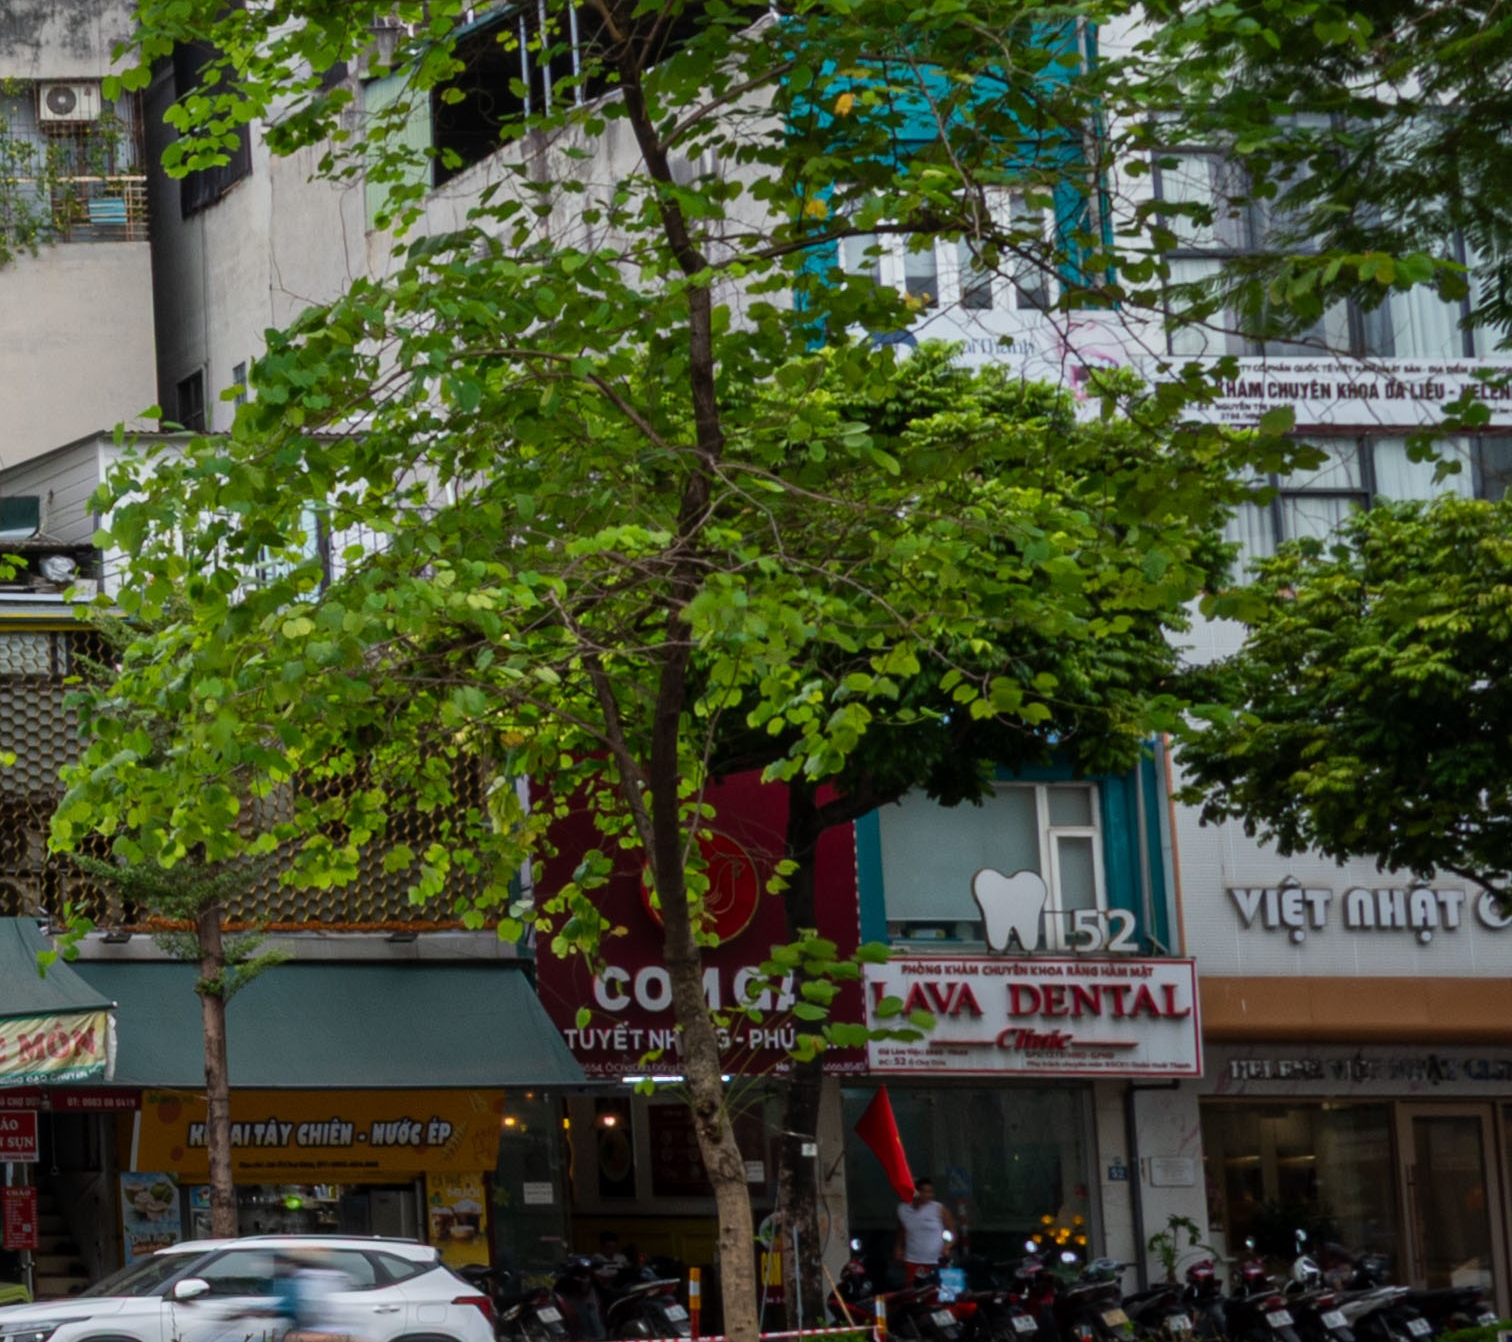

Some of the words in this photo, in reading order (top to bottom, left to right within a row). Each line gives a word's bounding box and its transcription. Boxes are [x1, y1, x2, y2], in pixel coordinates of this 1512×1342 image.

[1268, 379, 1331, 400] CHUYÊN
[1337, 382, 1379, 400] KHOA
[1227, 875, 1333, 944] VIỆT
[1344, 876, 1466, 945] NHẬT
[1072, 908, 1139, 953] 52
[1030, 965, 1064, 977] KHOA
[870, 981, 984, 1019] LAVA
[1007, 982, 1191, 1019] DENTAL
[15, 1020, 97, 1064] MÔN
[564, 1021, 644, 1051] TUYẾT
[995, 1027, 1073, 1051] Clinic
[6, 1136, 34, 1151] SỤN
[254, 1117, 293, 1147] TÂY
[296, 1117, 353, 1148] CHIÊN
[369, 1116, 423, 1147] NƯỚC
[426, 1114, 453, 1147] ÉP
